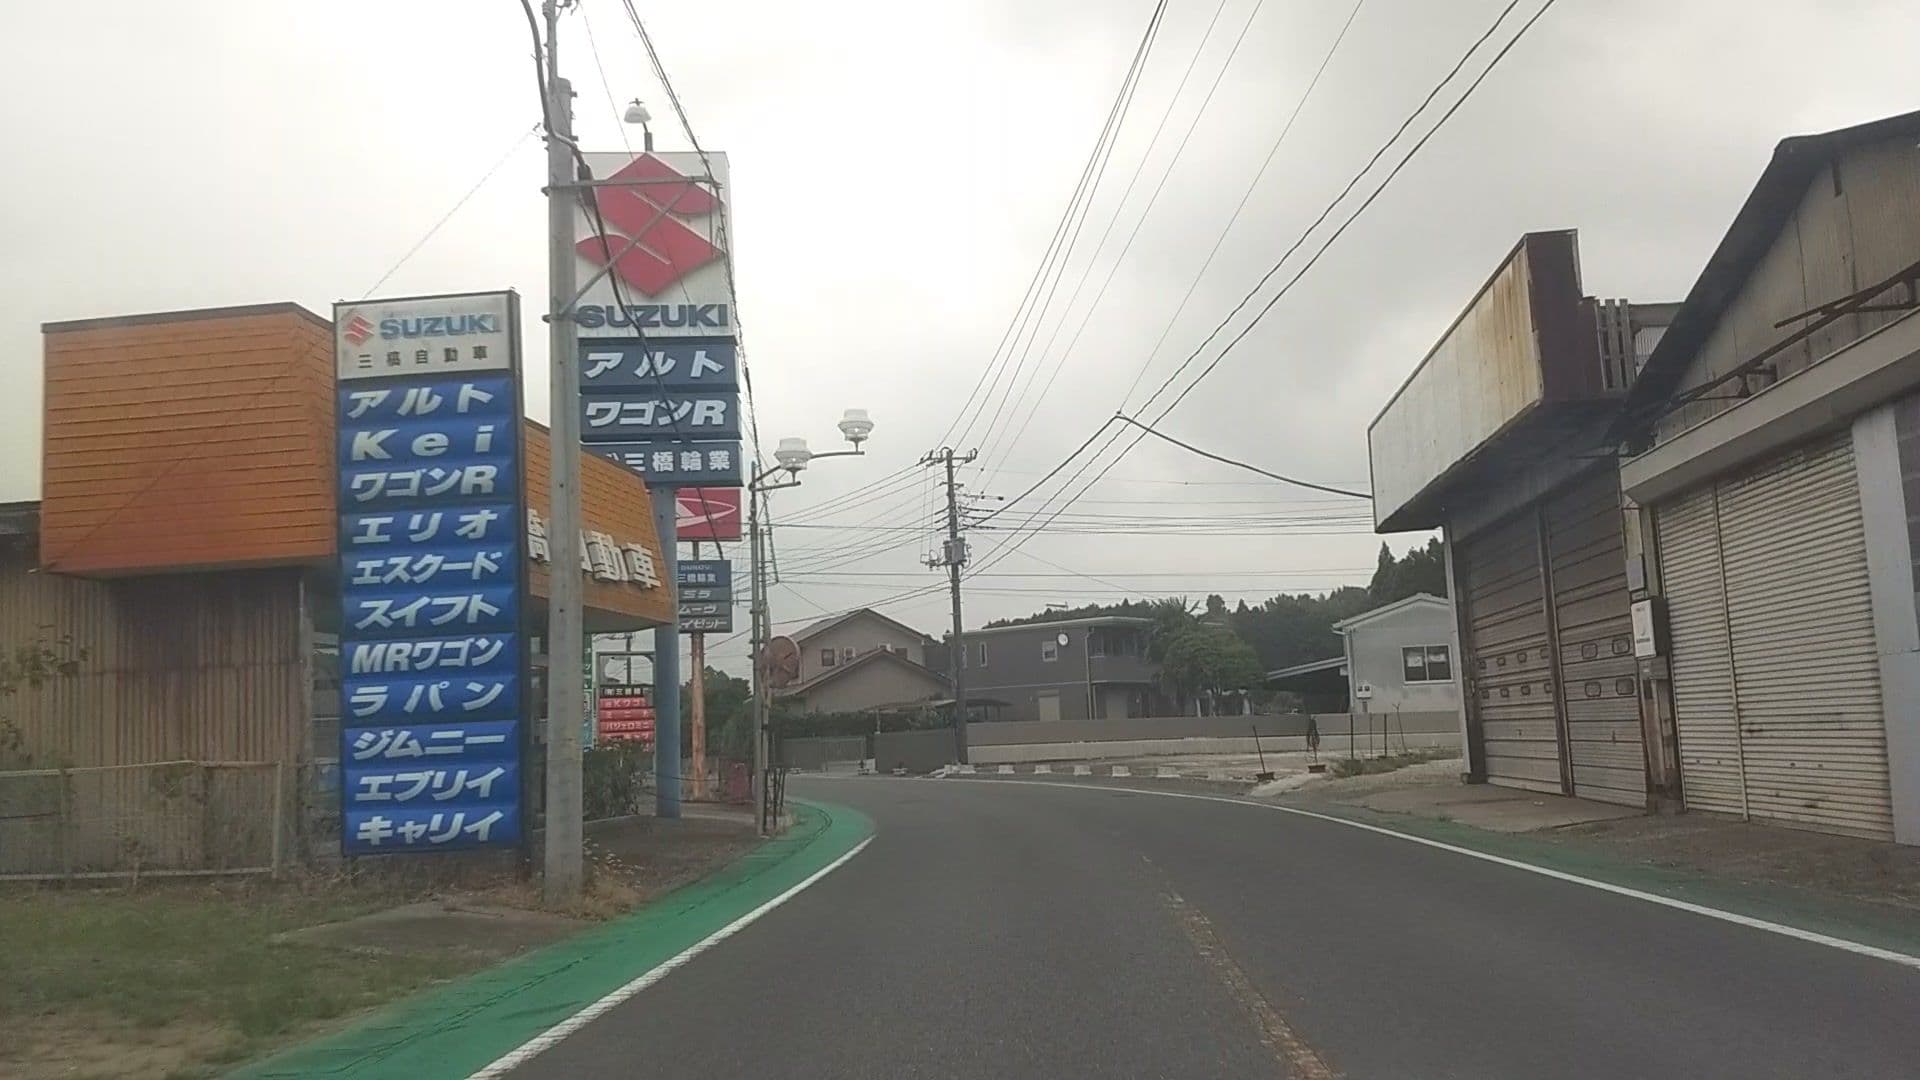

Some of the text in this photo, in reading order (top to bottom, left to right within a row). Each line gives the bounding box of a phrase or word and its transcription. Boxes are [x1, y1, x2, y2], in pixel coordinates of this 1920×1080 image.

[380, 315, 501, 340] SUZUKI
[578, 304, 728, 328] SUZUKI
[585, 351, 725, 378] アルト
[348, 384, 493, 418] アルト
[585, 400, 726, 427] ワゴンR
[352, 425, 493, 461] Kei
[606, 450, 730, 472] 三橋輪業
[351, 465, 497, 502] ワゴンR
[352, 509, 498, 544] エリオ
[352, 551, 502, 585] エスクード
[355, 594, 500, 630] スイフト
[352, 638, 504, 674] MRワゴン
[350, 683, 504, 717] ラパン
[353, 729, 506, 760] ジムニー
[355, 767, 506, 802] エブリイ
[356, 810, 504, 845] キャリイ
